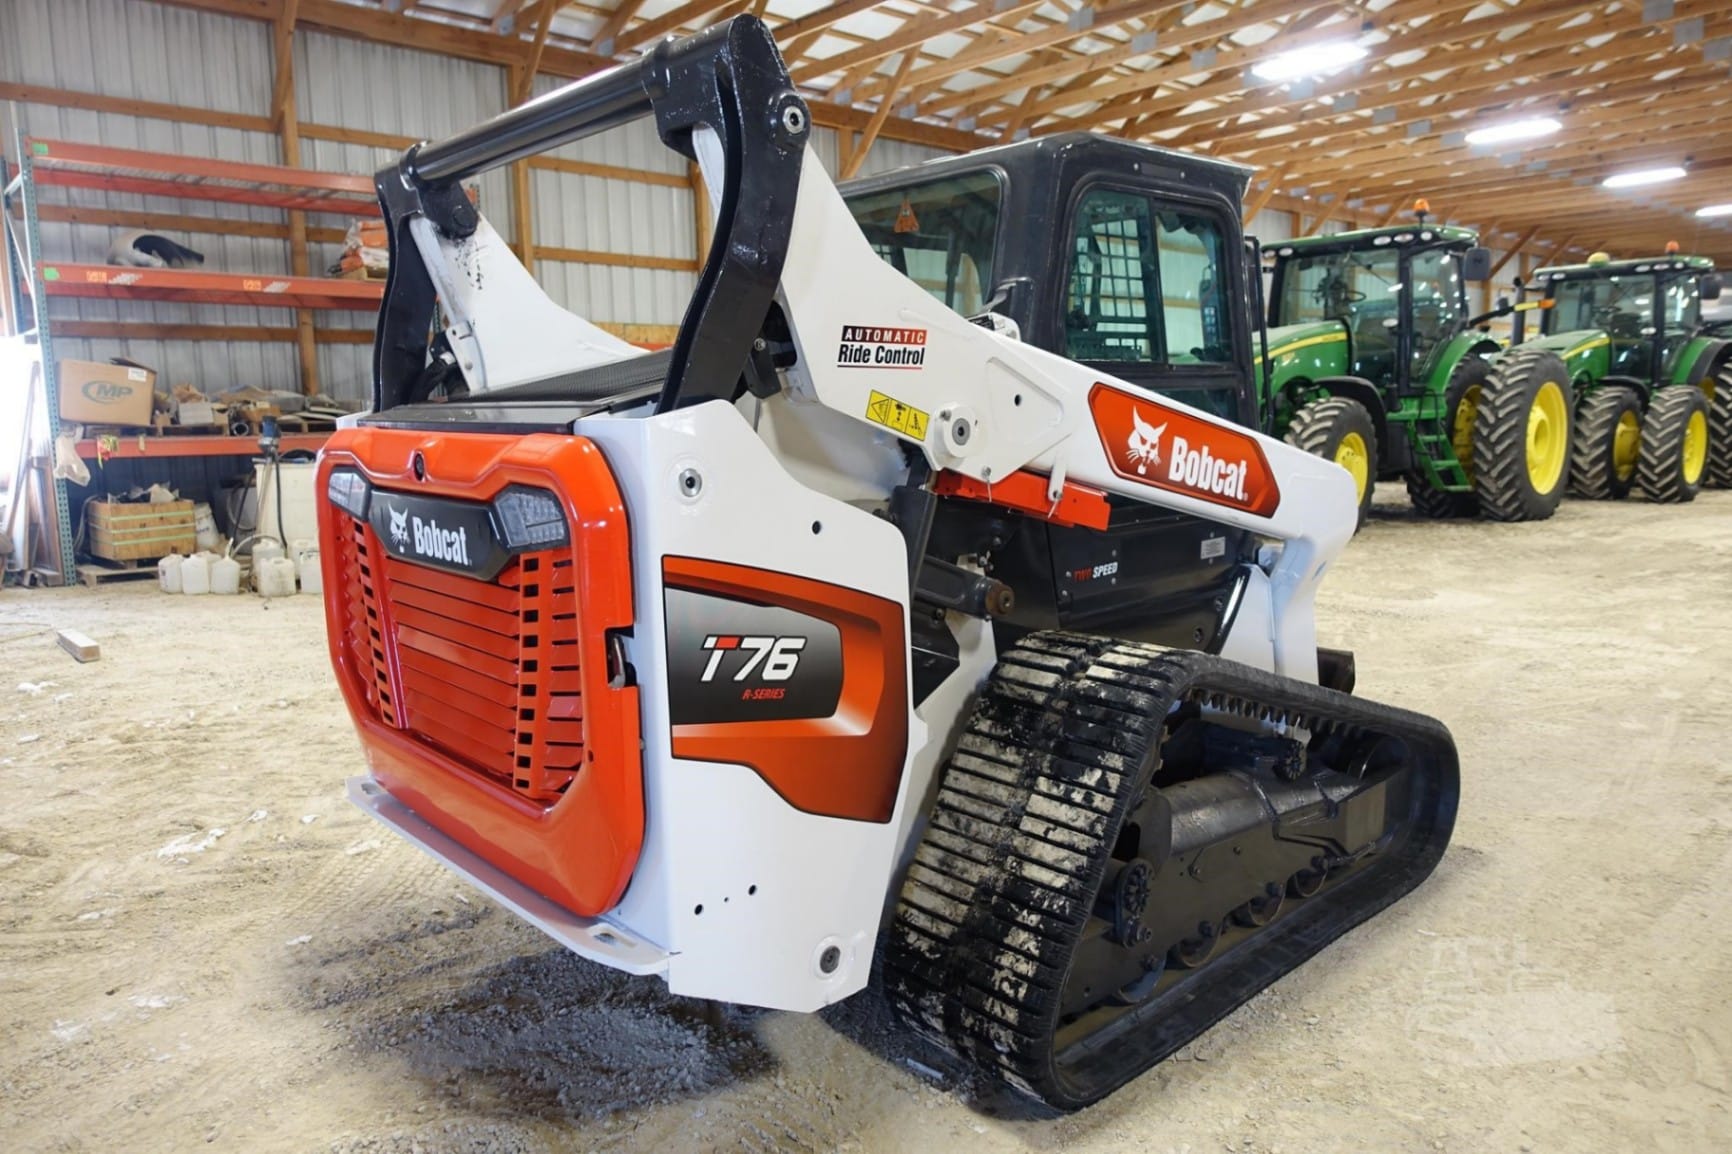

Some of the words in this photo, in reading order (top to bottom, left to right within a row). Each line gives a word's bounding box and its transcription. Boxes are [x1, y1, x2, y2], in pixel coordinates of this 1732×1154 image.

[844, 327, 925, 344] AUTOMATIC
[838, 344, 871, 363] Ride
[875, 345, 925, 365] Control
[1168, 435, 1248, 501] Bobcat
[412, 516, 469, 566] Bobcat
[1092, 561, 1118, 579] SPEED
[700, 635, 807, 682] T76
[742, 688, 786, 700] R-SERIES
